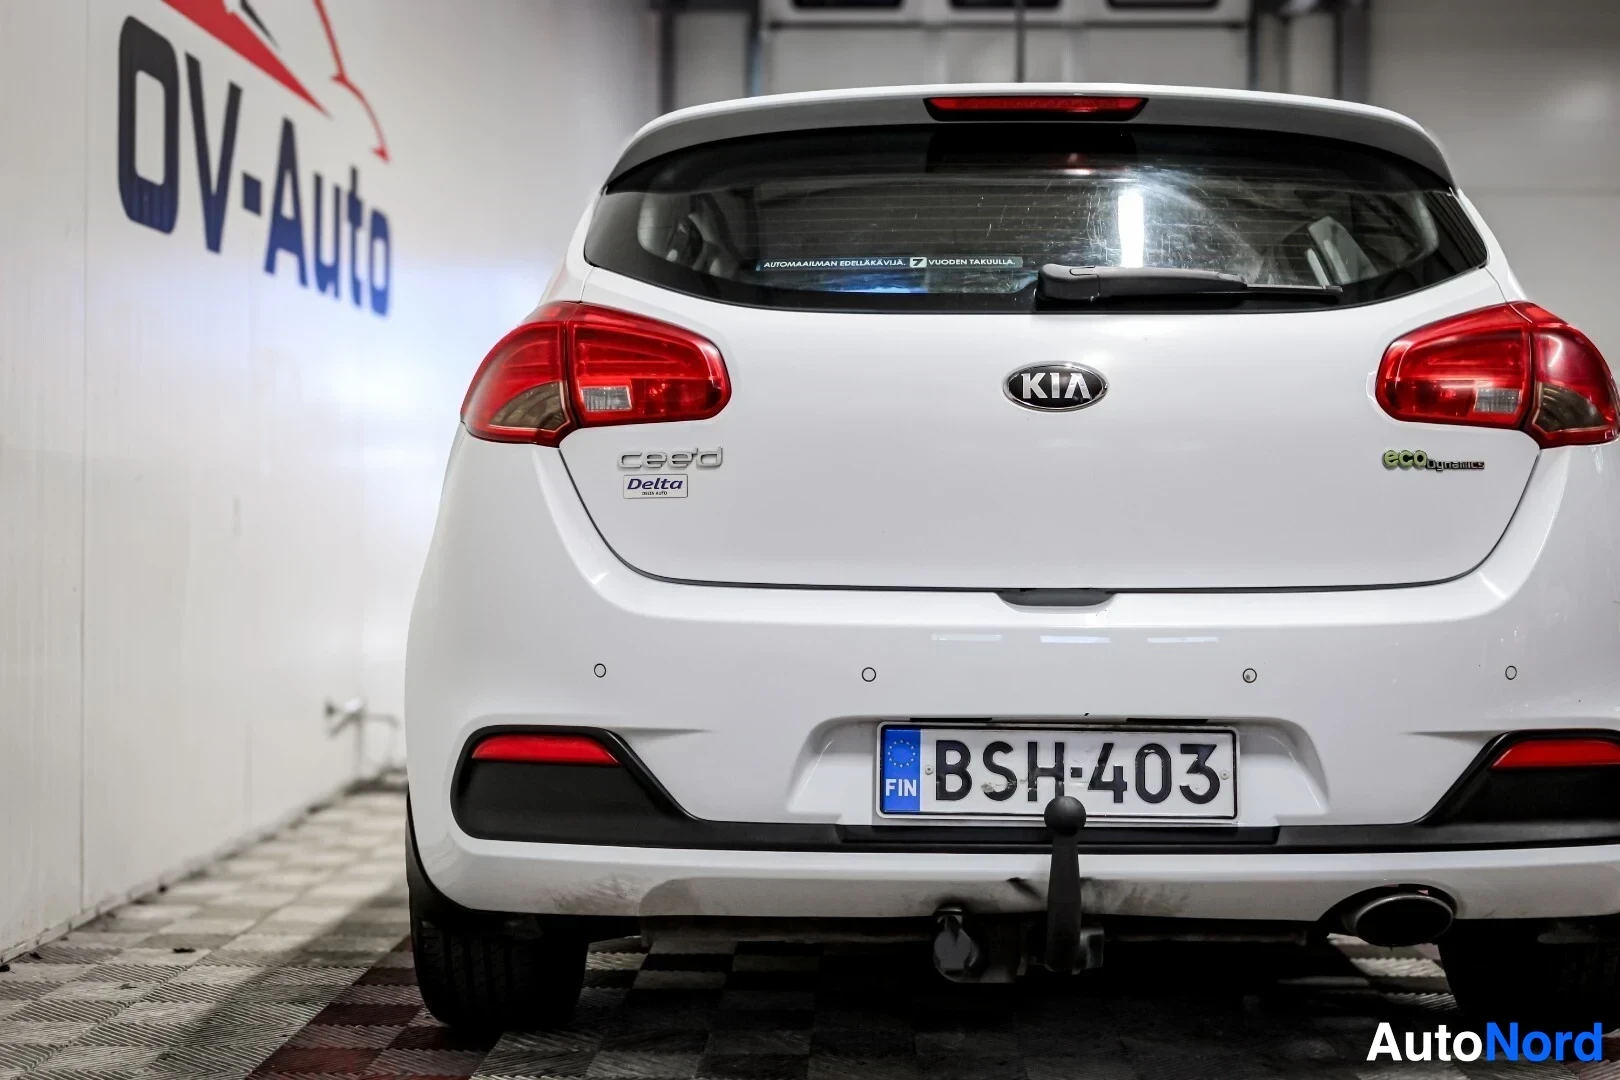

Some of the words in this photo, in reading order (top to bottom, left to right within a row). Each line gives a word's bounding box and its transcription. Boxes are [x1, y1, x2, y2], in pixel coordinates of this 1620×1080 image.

[118, 15, 391, 318] OV-Auto
[1021, 372, 1091, 399] KIA
[627, 477, 683, 490] Delta
[935, 739, 1221, 804] BSH-403
[885, 778, 917, 797] FIN
